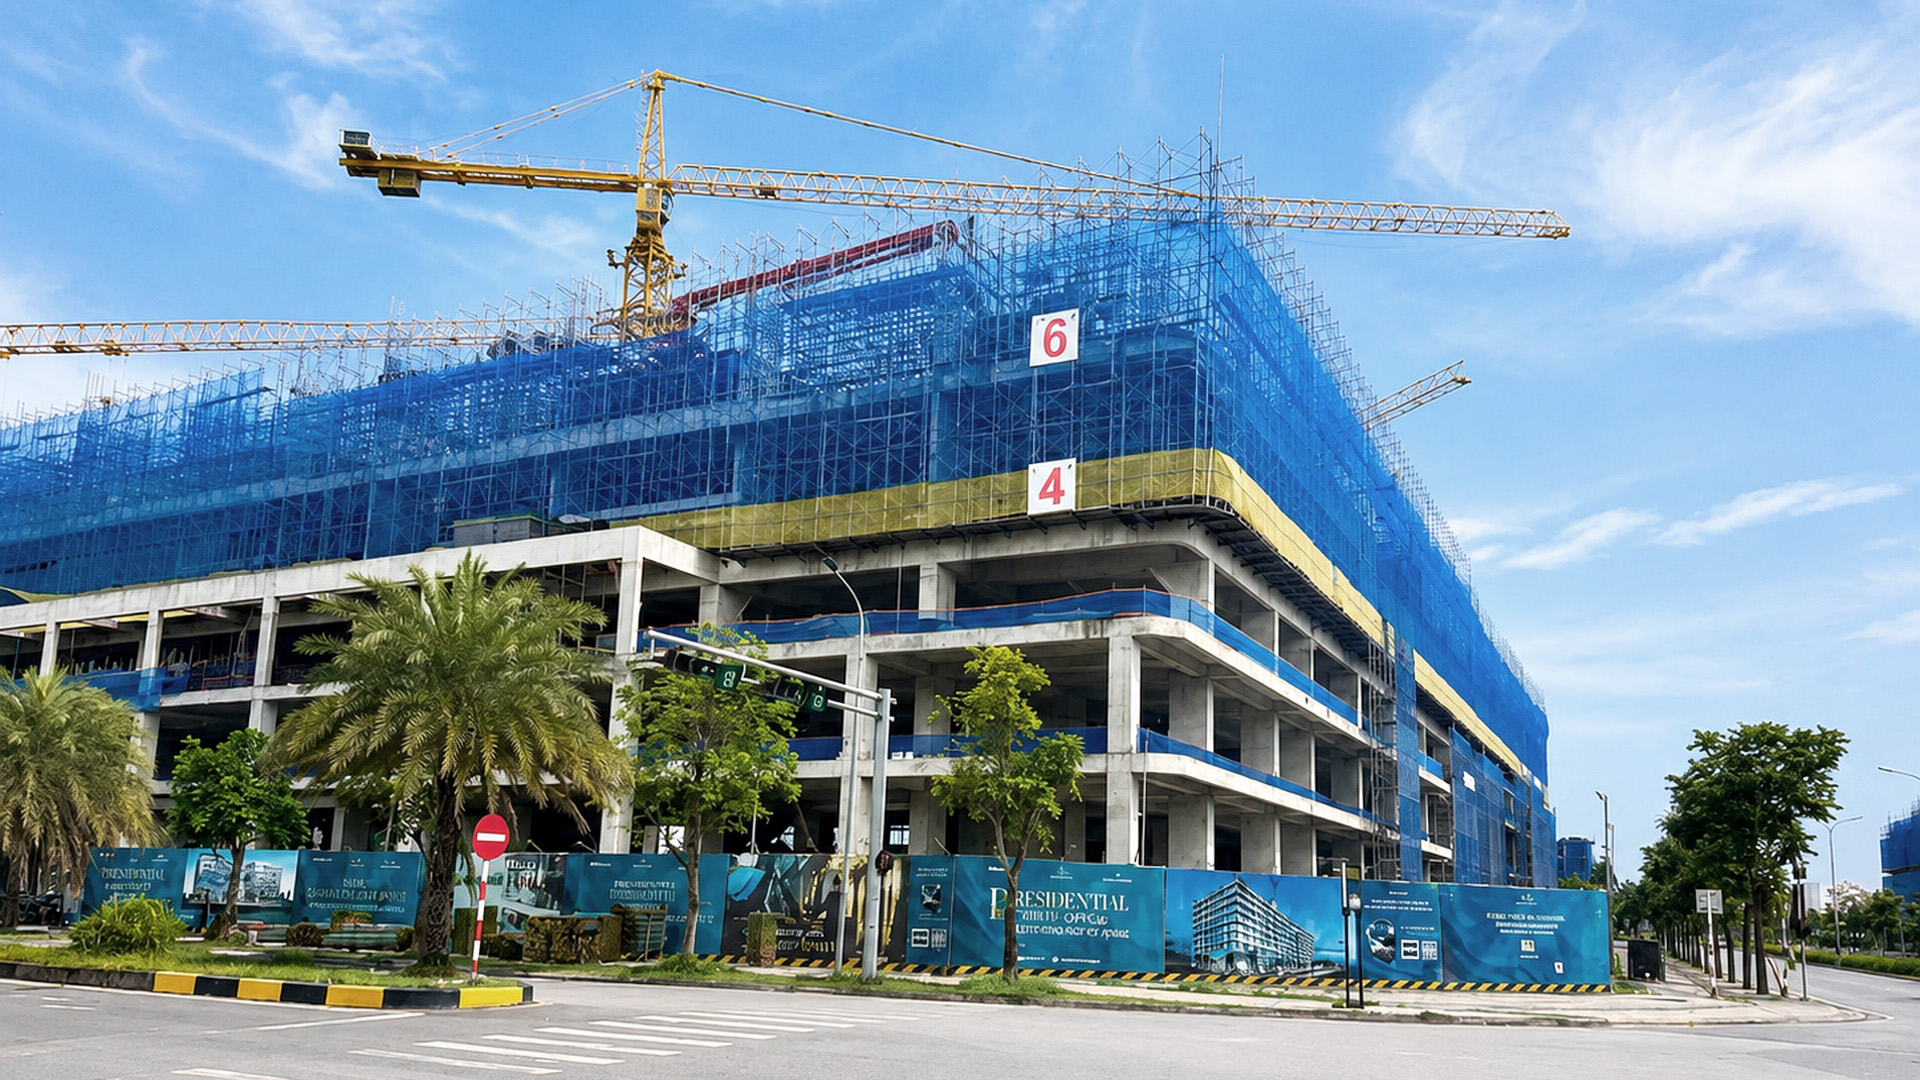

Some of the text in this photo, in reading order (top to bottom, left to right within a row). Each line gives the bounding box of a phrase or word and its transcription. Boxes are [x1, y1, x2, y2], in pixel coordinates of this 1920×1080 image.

[1043, 318, 1067, 358] 6
[1038, 466, 1066, 505] 4
[990, 887, 1129, 920] PRESIDENTIAL
